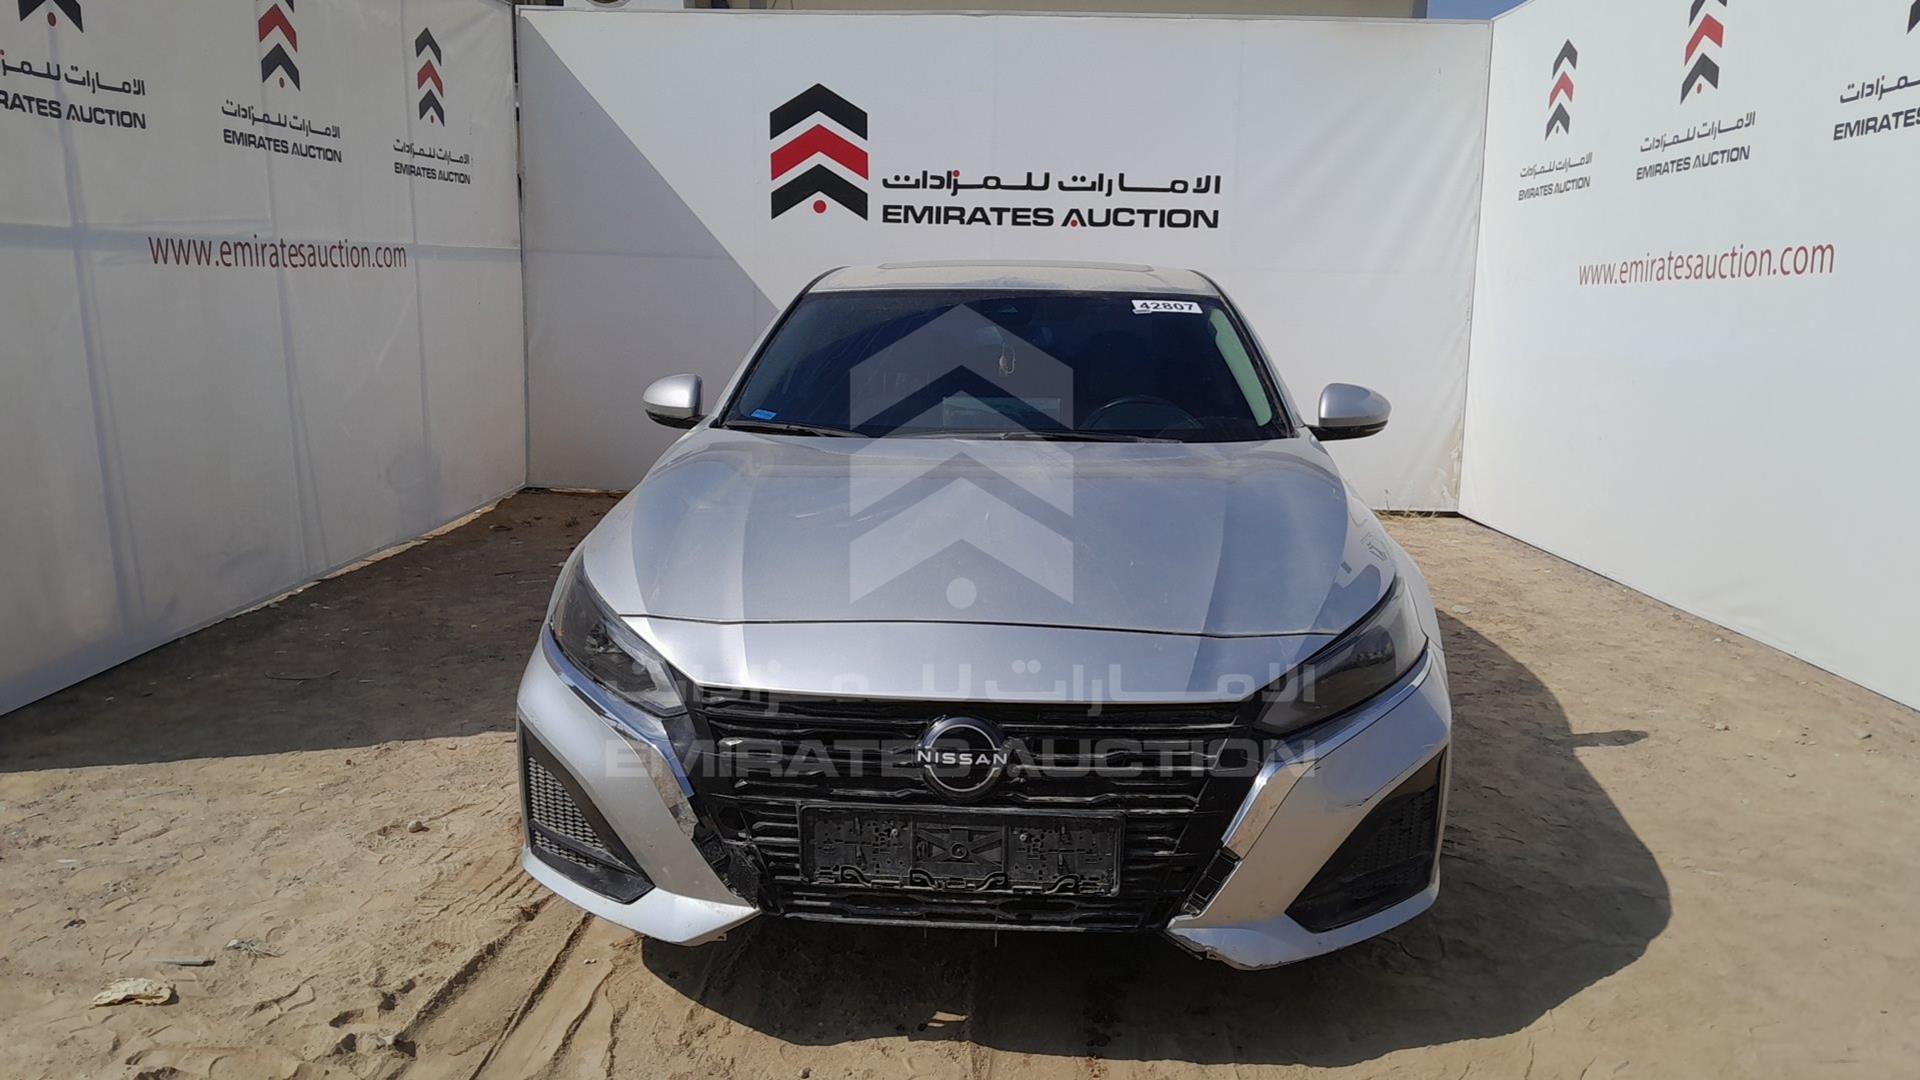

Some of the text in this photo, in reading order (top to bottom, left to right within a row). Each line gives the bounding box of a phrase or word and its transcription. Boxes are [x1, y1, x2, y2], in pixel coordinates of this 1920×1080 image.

[64, 64, 146, 96] الامارات
[66, 103, 147, 129] AUCTION
[223, 128, 342, 163] EMIRATES AUCTION
[394, 161, 471, 185] EMIRATES AUCTION
[1636, 145, 1751, 180] EMIRATES AUCTION
[882, 170, 1222, 197] الامارات للمزادات
[1518, 176, 1591, 201] EMIRATES AUCTION
[882, 204, 1219, 229] EMIRATES AUCTION
[148, 234, 407, 268] www.emiratesauction.com
[1578, 241, 1836, 286] www.emiratesauction.com
[1140, 302, 1194, 311] 42807
[917, 750, 1007, 765] NISSAN
